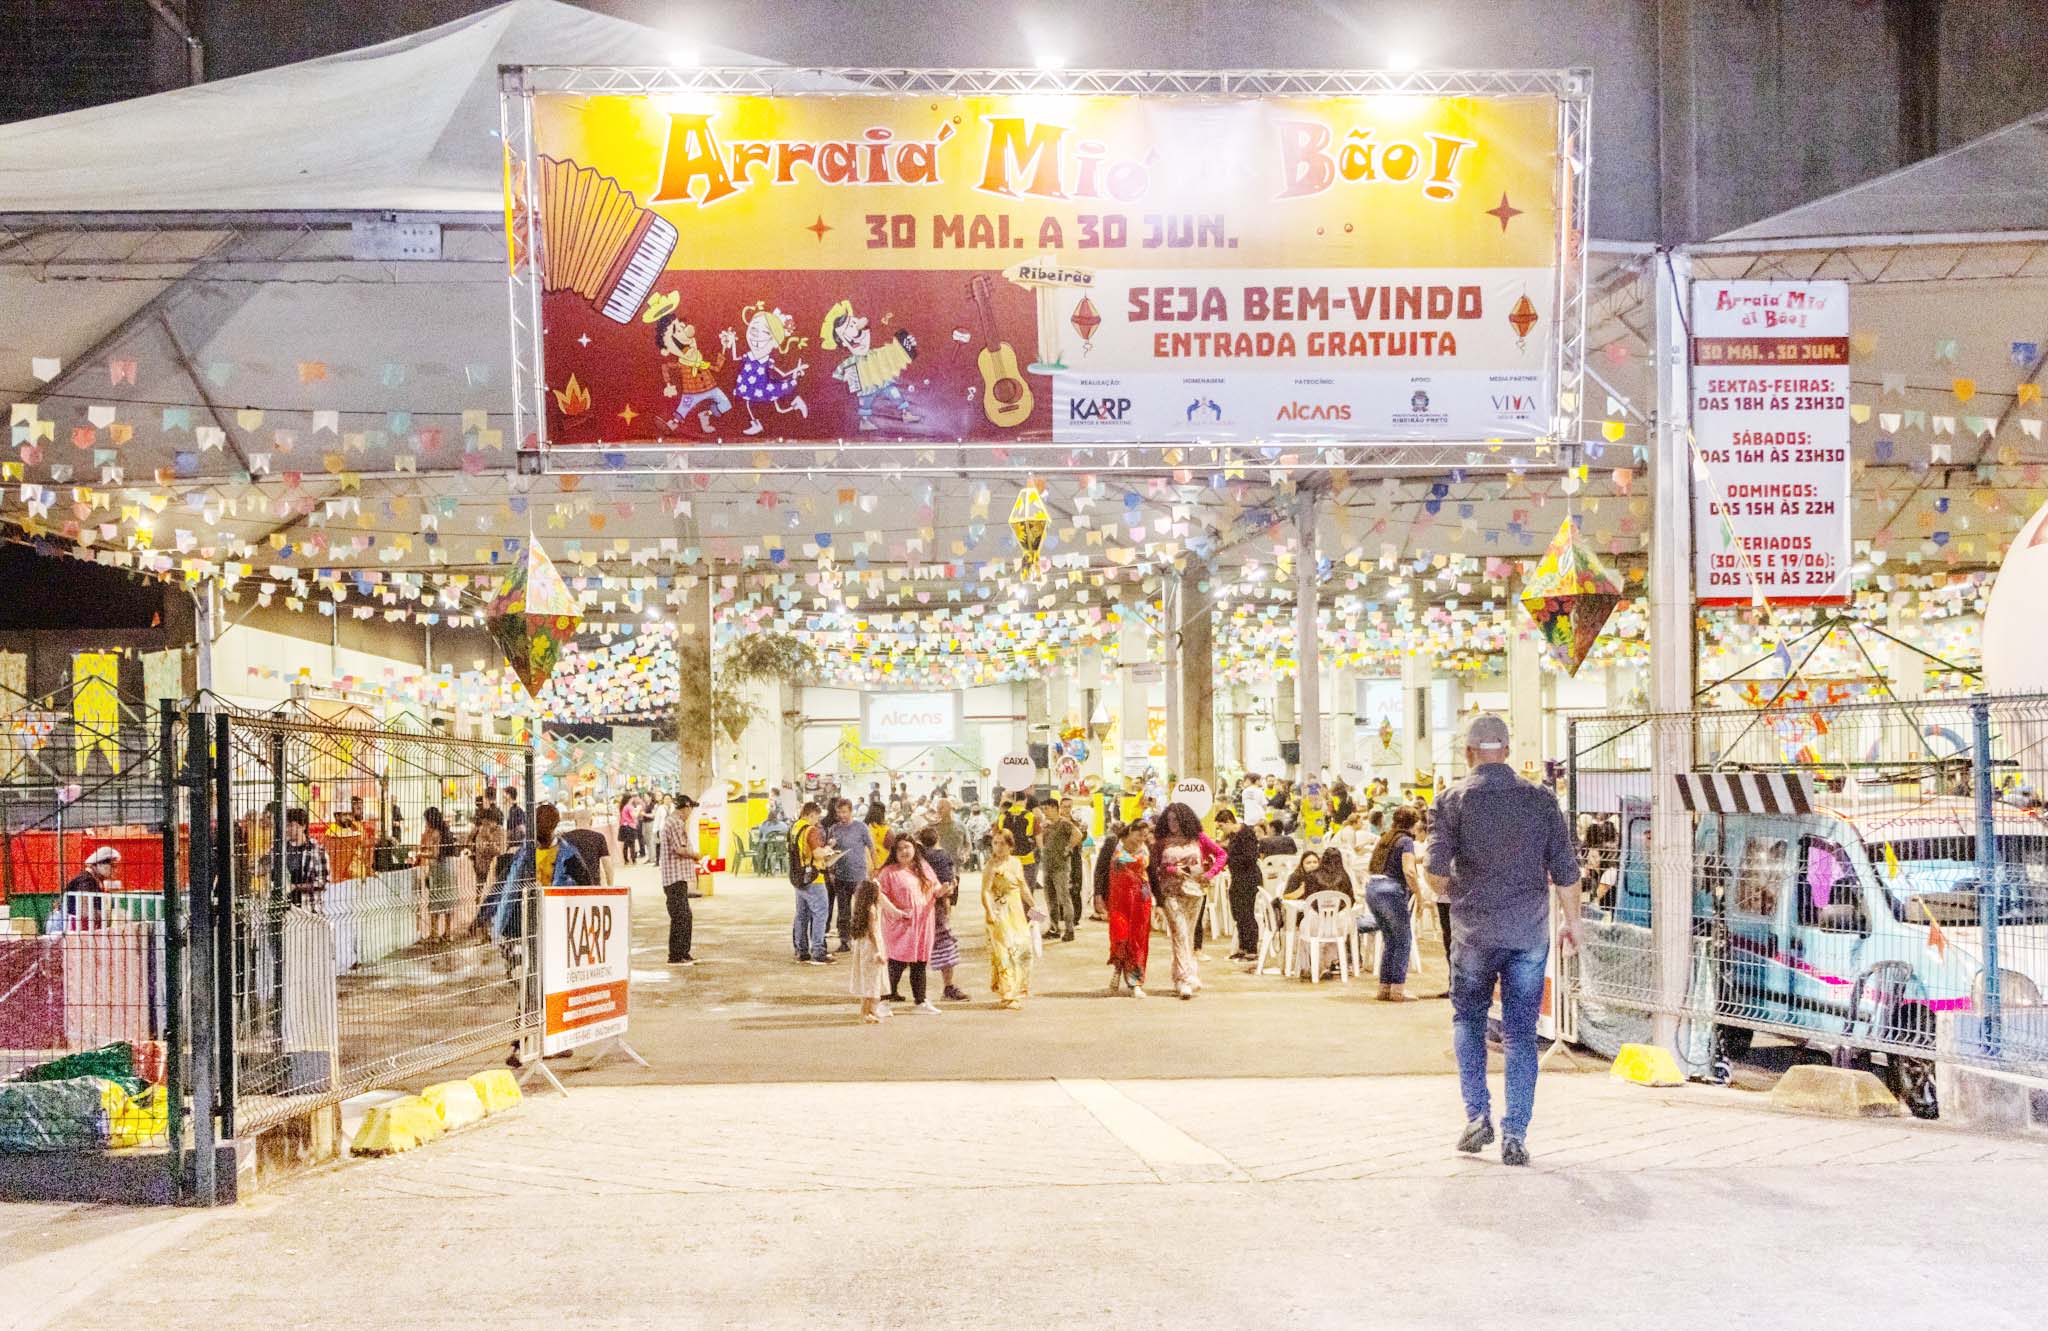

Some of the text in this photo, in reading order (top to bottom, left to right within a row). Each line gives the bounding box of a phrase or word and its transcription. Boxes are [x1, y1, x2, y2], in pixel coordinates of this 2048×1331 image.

[1272, 119, 1477, 201] Bão!
[866, 214, 1239, 249] 30 MAI. A 30 JUN.
[1019, 266, 1092, 284] Ribeirão
[1128, 285, 1483, 322] SEJA BEM-VINDO
[1154, 331, 1457, 358] ENTRADA GRATUITA
[1701, 344, 1723, 360] 30
[1727, 344, 1764, 360] MAI.
[1776, 344, 1798, 360] 30
[1802, 344, 1841, 360] JUN.
[1708, 379, 1836, 393] SEXTAS-FEIRAS:
[1698, 394, 1845, 410] DAS 18H ÀS 23H30
[1732, 429, 1812, 446] SÁBADOS:
[1700, 446, 1845, 463] DAS 16H ÀS 23H30
[1727, 484, 1818, 498] DOMINGOS:
[1710, 499, 1835, 516] DAS 15H ÀS 22H
[1767, 554, 1776, 568] E
[1781, 552, 1835, 569] 19/06):
[1710, 571, 1741, 586] DAS
[1780, 568, 1800, 585] ÀS
[1805, 571, 1836, 585] 22H
[1003, 756, 1030, 766] CAIXA
[1178, 783, 1206, 793] CAIXA
